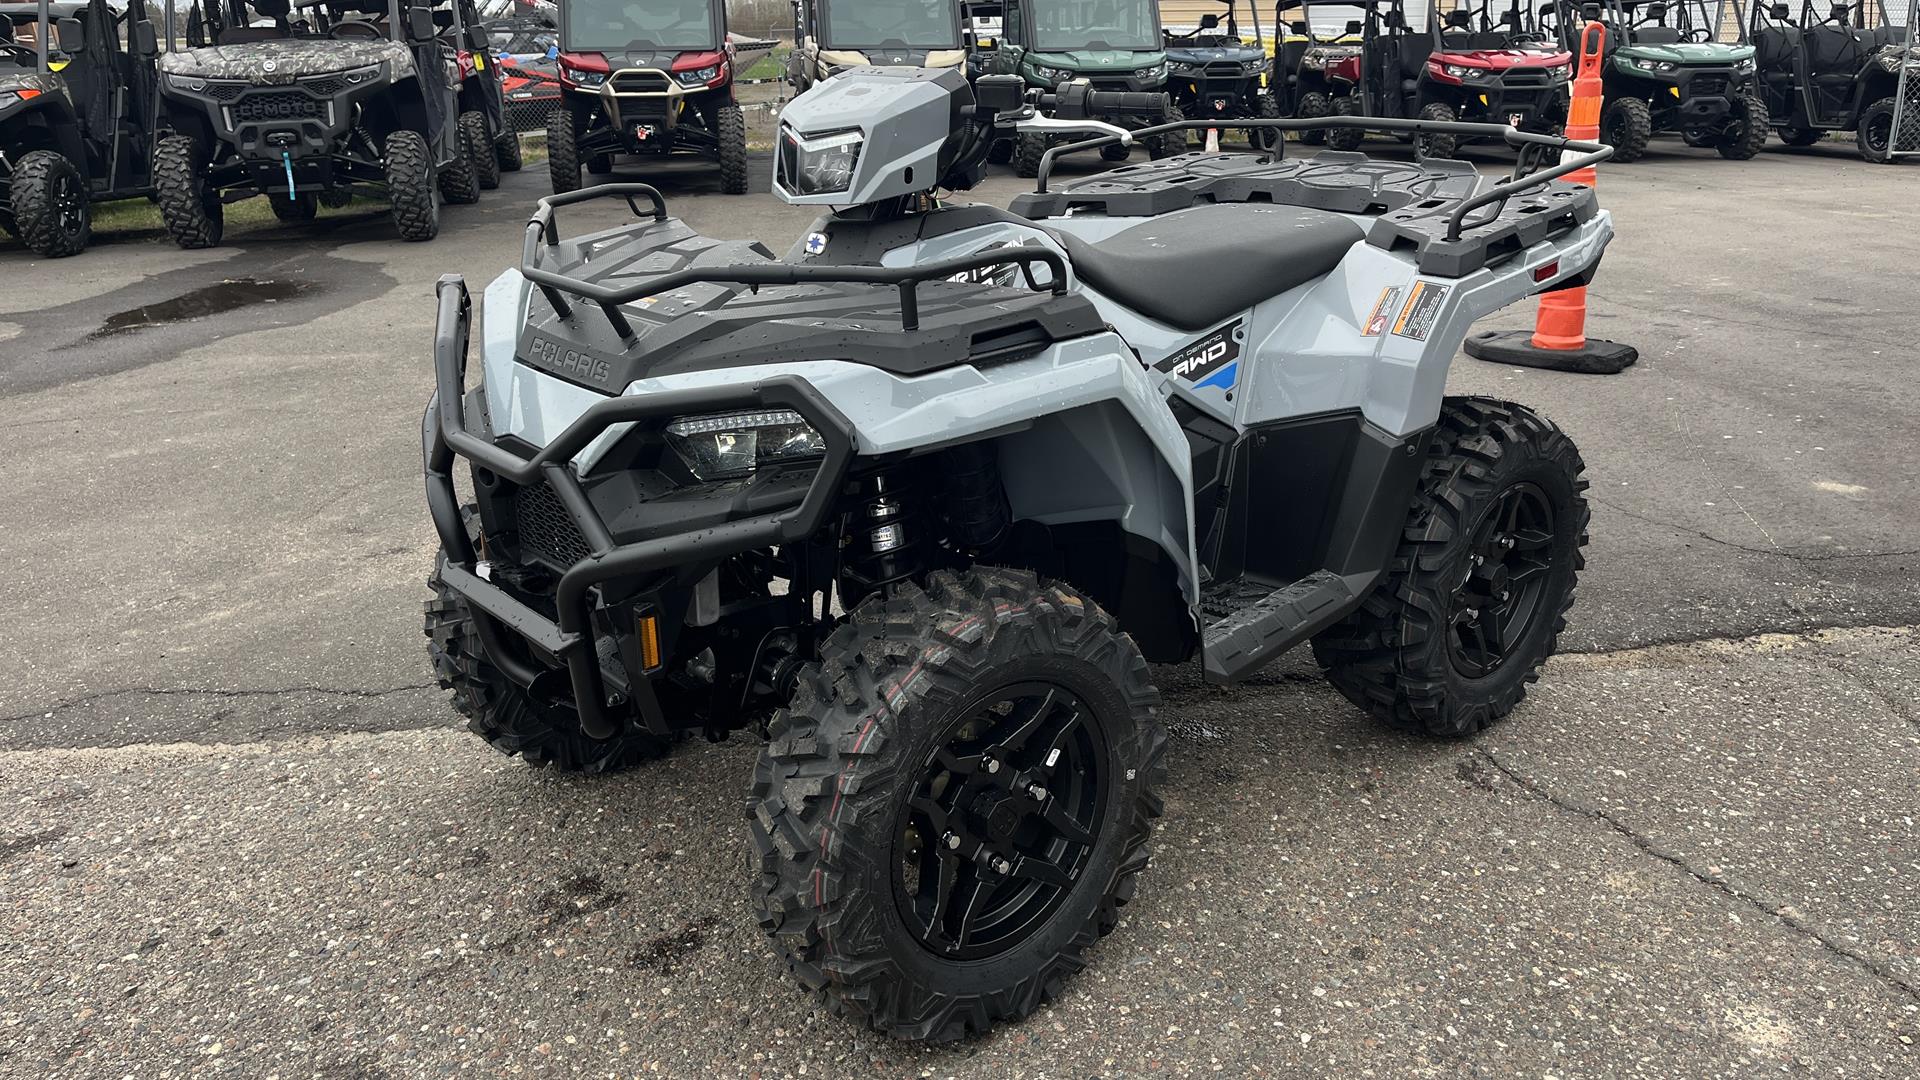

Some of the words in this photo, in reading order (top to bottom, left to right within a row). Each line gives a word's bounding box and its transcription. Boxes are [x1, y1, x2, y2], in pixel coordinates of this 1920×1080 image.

[528, 336, 610, 382] POLARIS
[1172, 341, 1227, 381] AWD
[1186, 334, 1223, 356] DEMAND
